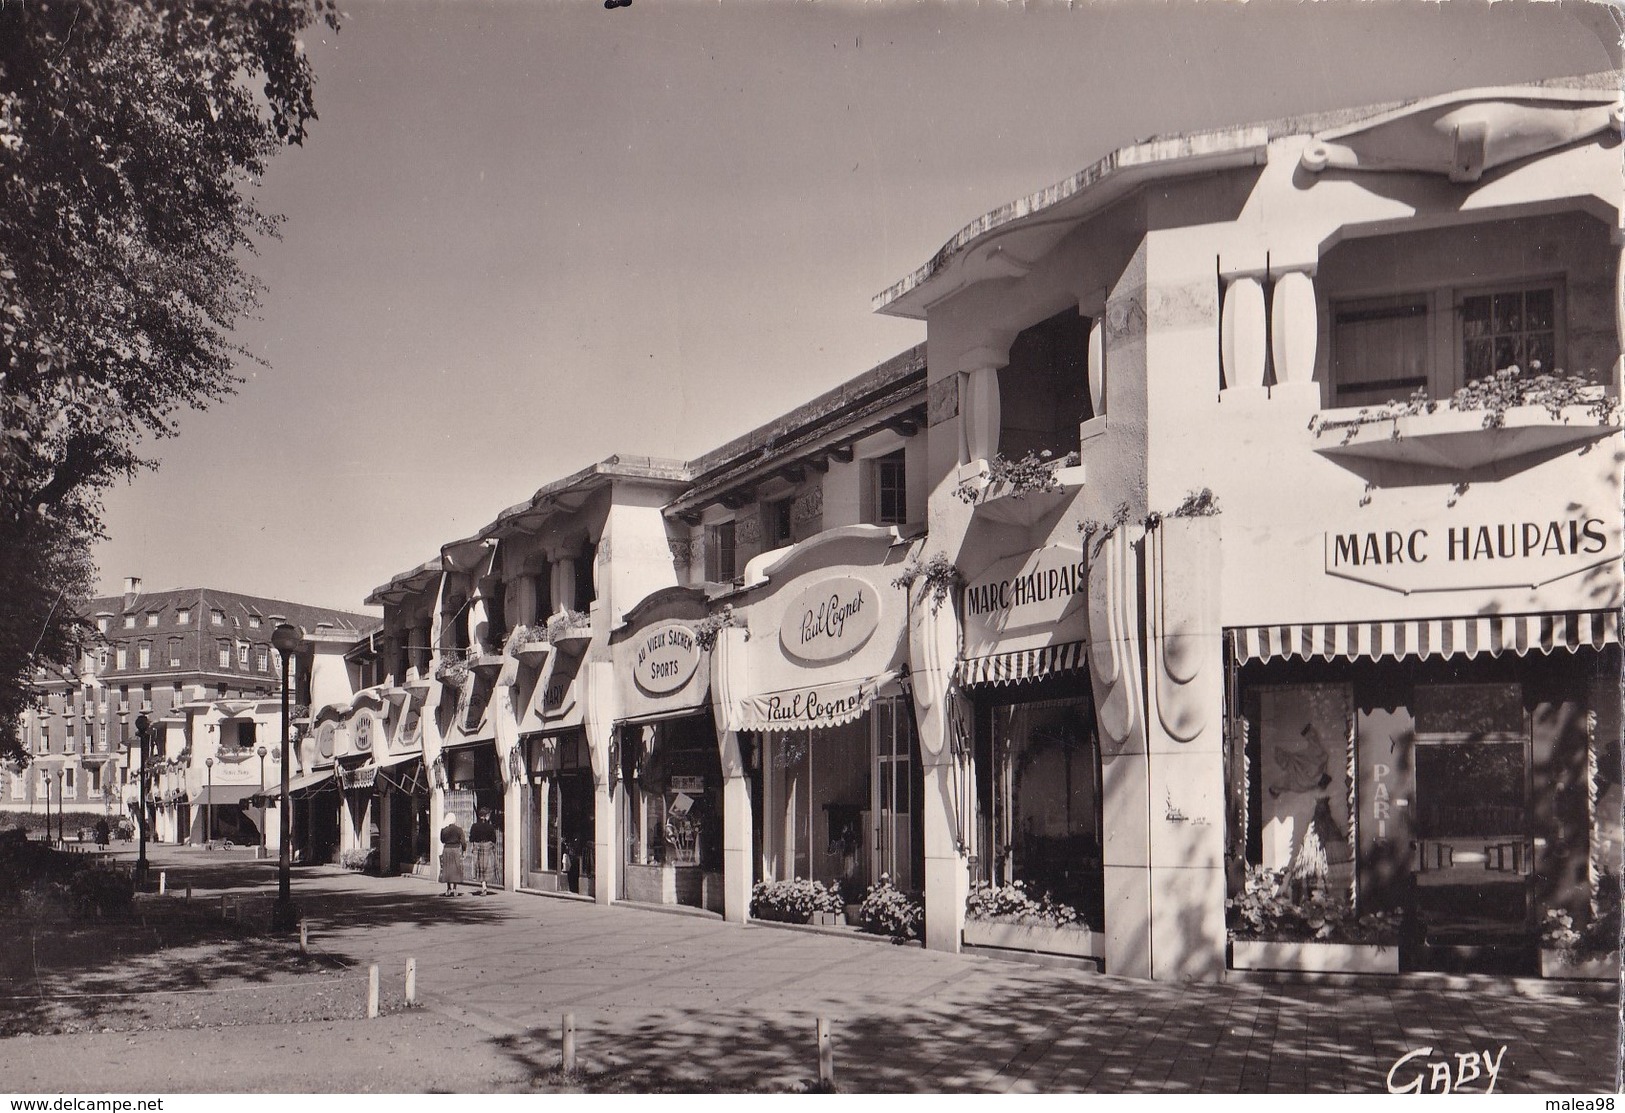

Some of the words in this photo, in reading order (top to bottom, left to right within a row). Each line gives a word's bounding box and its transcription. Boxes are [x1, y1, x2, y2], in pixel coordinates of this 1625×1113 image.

[1334, 529, 1428, 567] MARC
[1448, 518, 1607, 561] HAUPAIS
[968, 580, 1009, 617] MARC
[1015, 561, 1084, 607] HAUPAIS
[801, 602, 826, 645] Paul
[638, 646, 646, 667] AU
[647, 633, 665, 653] VIEUX
[669, 630, 693, 653] SACHEM
[651, 660, 678, 680] SPORTS
[767, 694, 802, 722] Paul
[1373, 763, 1391, 841] PARI
